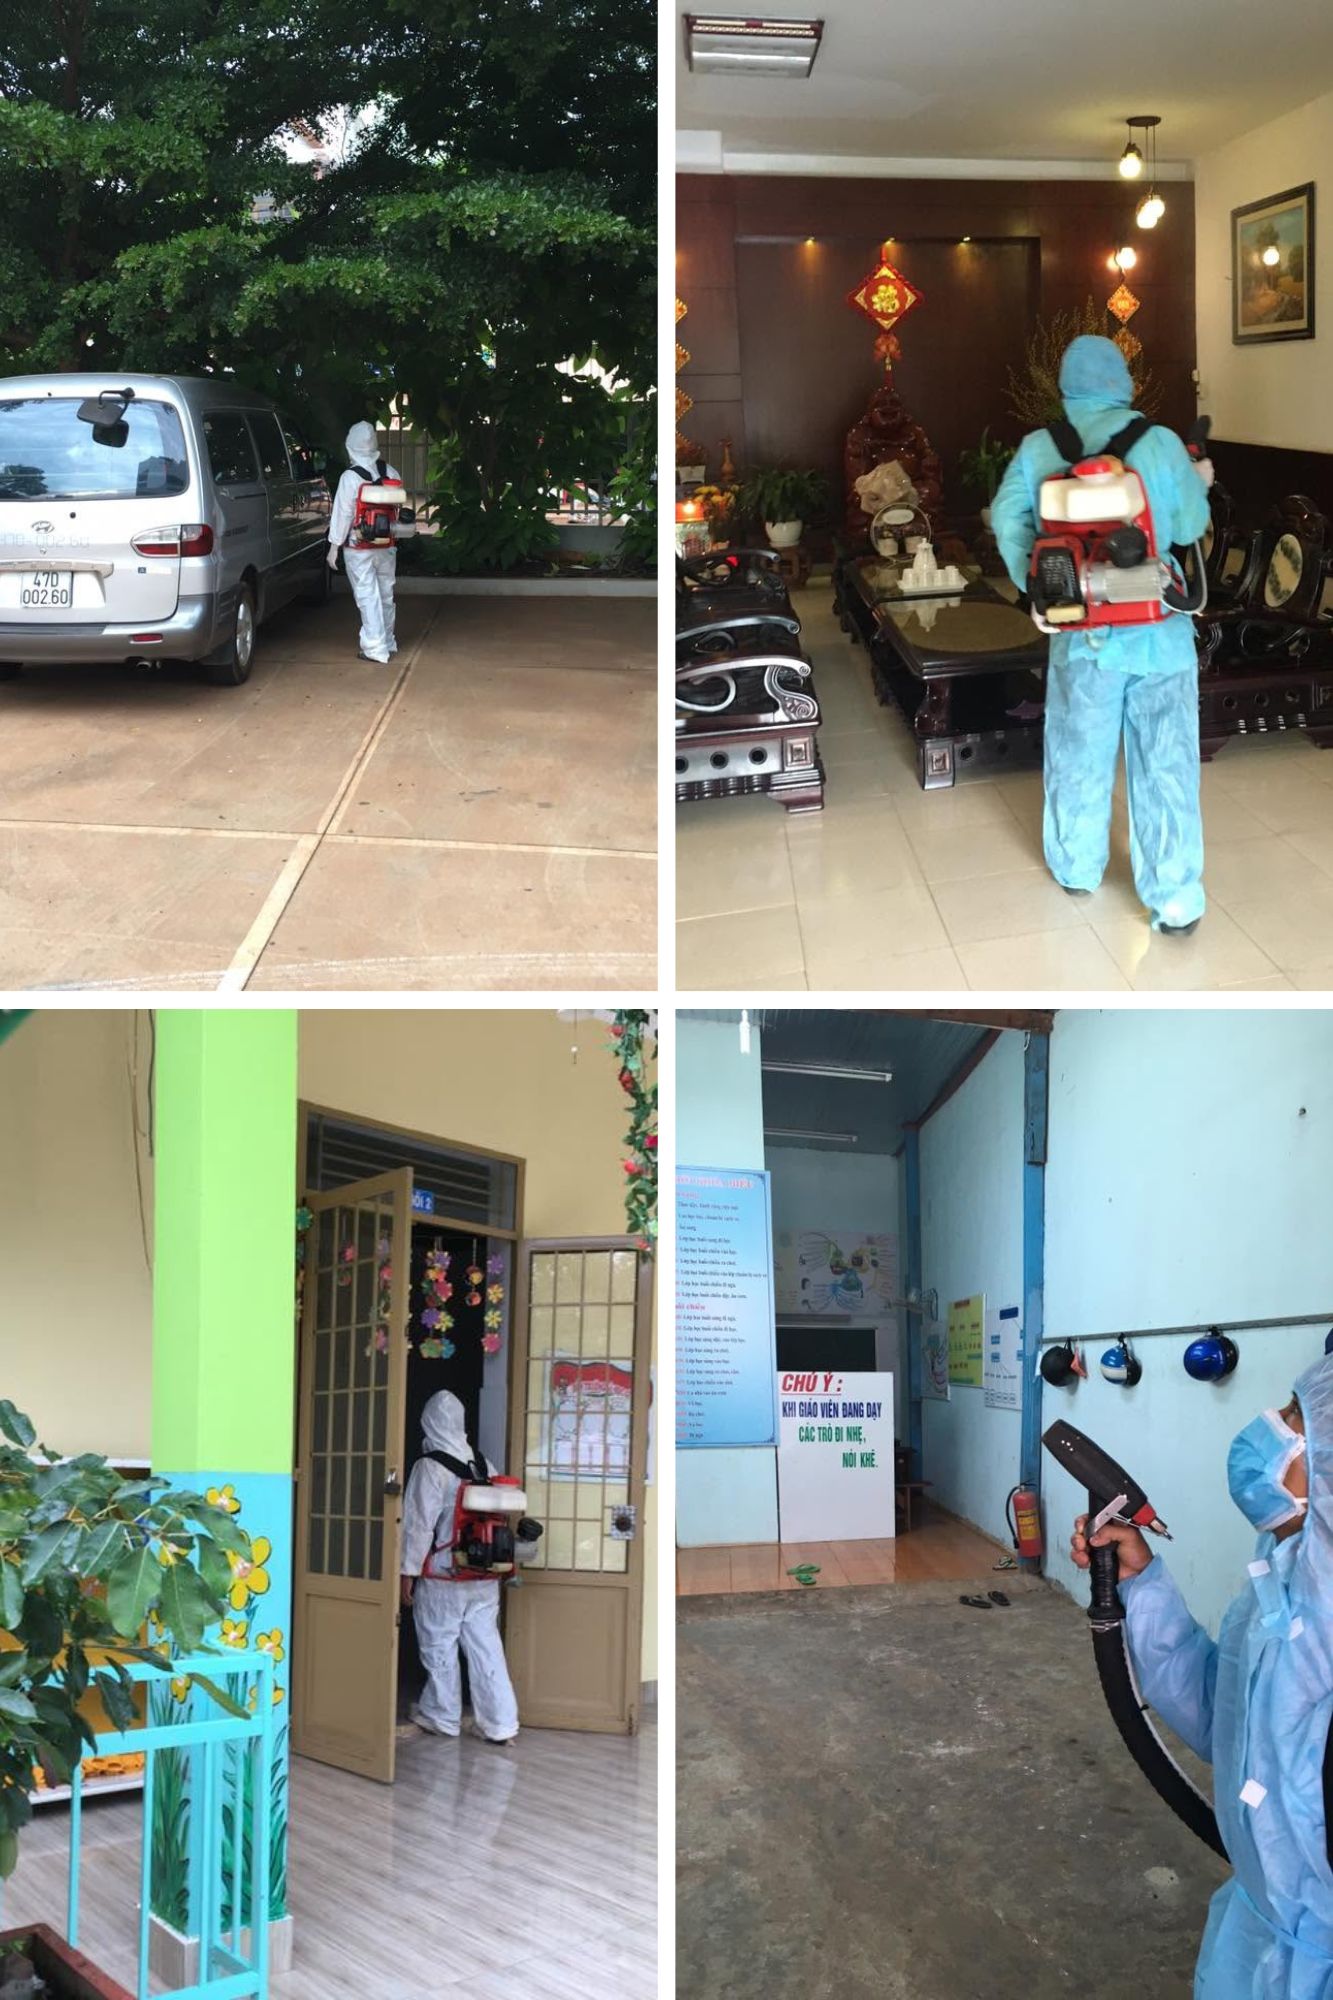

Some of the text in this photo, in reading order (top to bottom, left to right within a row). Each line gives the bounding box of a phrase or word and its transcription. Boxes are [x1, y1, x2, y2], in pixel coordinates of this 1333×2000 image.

[33, 571, 59, 588] 47D
[22, 589, 68, 605] 002.60
[782, 1371, 818, 1392] CHÚ
[782, 1398, 882, 1420] KHI GIÁO VIÊN ĐANG DẠY
[798, 1422, 815, 1442] CÁC
[817, 1422, 833, 1442] TRÒ
[835, 1426, 843, 1442] ĐI
[842, 1448, 856, 1468] NÓI
